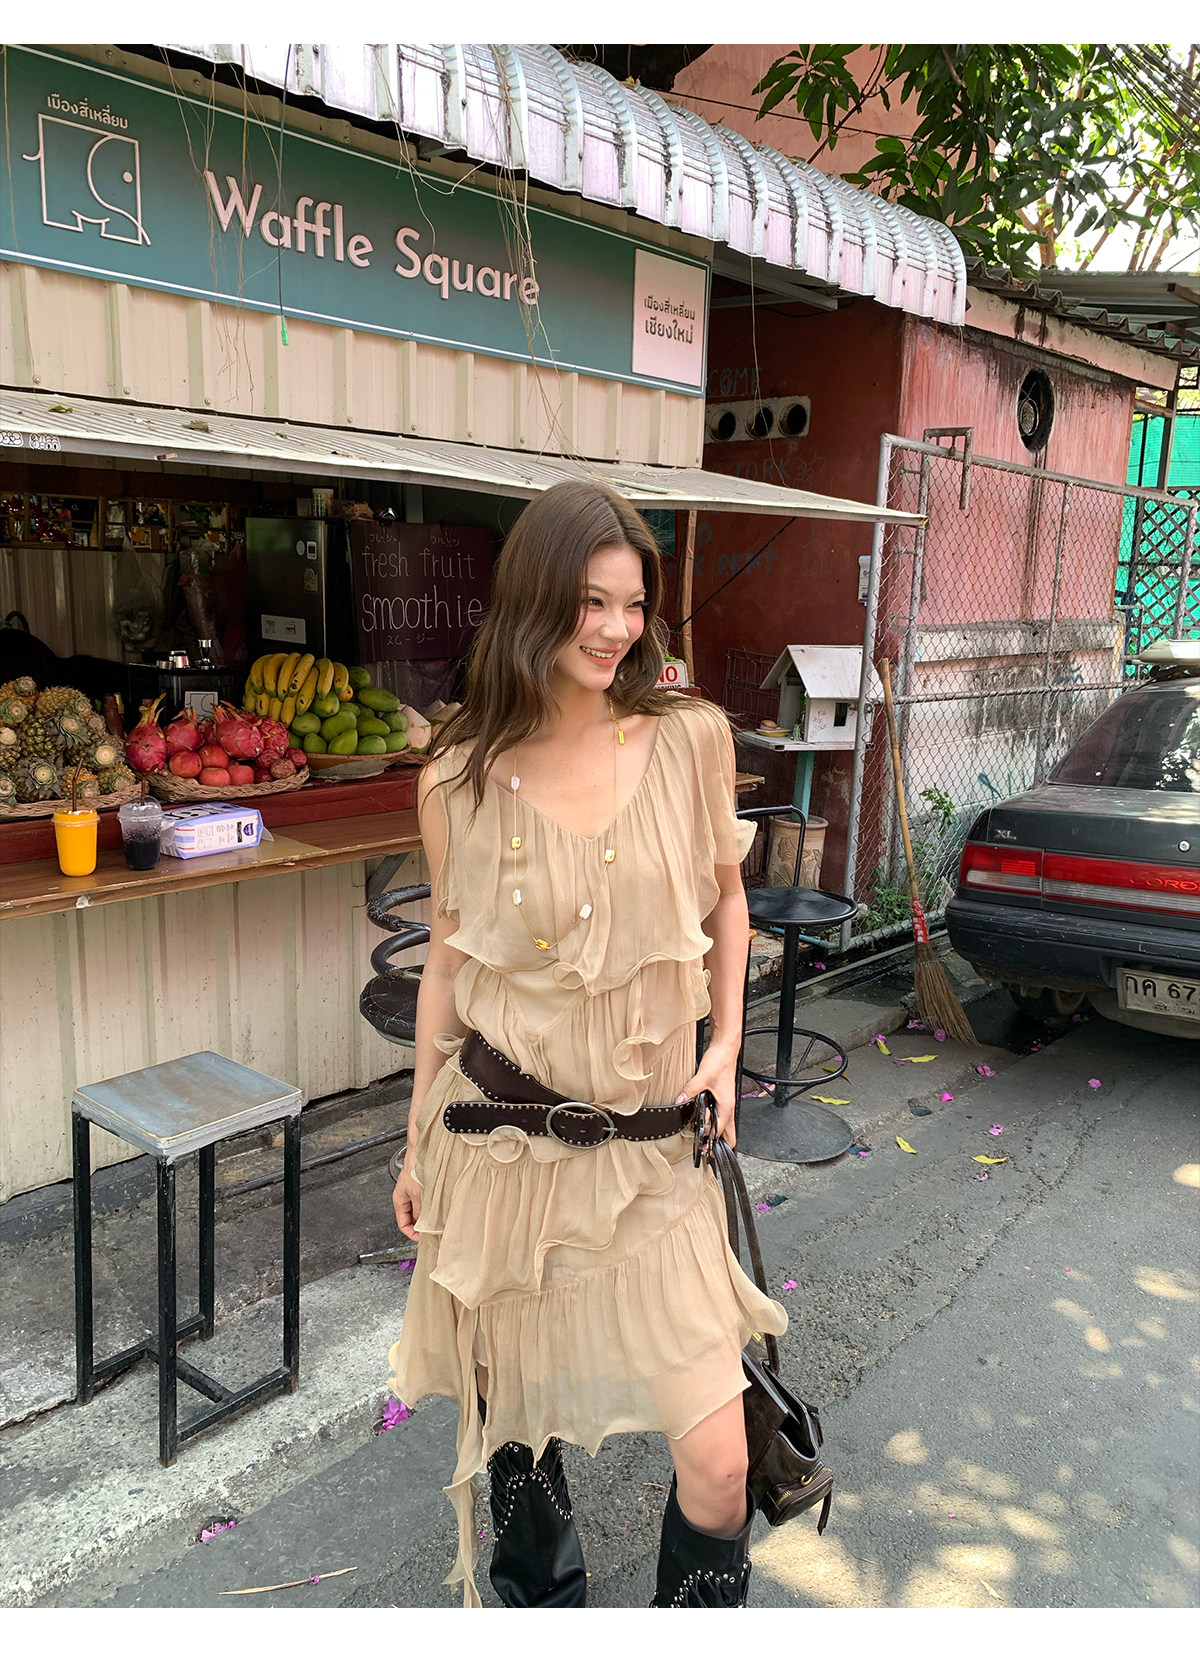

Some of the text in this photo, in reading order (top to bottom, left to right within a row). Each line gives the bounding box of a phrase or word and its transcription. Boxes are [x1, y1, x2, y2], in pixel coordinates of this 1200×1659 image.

[47, 93, 129, 129] เมืองสี่เหลี่ยม
[204, 169, 541, 306] Waffle Square
[644, 295, 696, 321] เมืองสี่เหลี่ยม
[645, 316, 694, 345] เชียงใหม่
[361, 541, 476, 580] fresh fruit
[361, 584, 483, 633] smoothie
[1126, 975, 1200, 1002] กค 67
